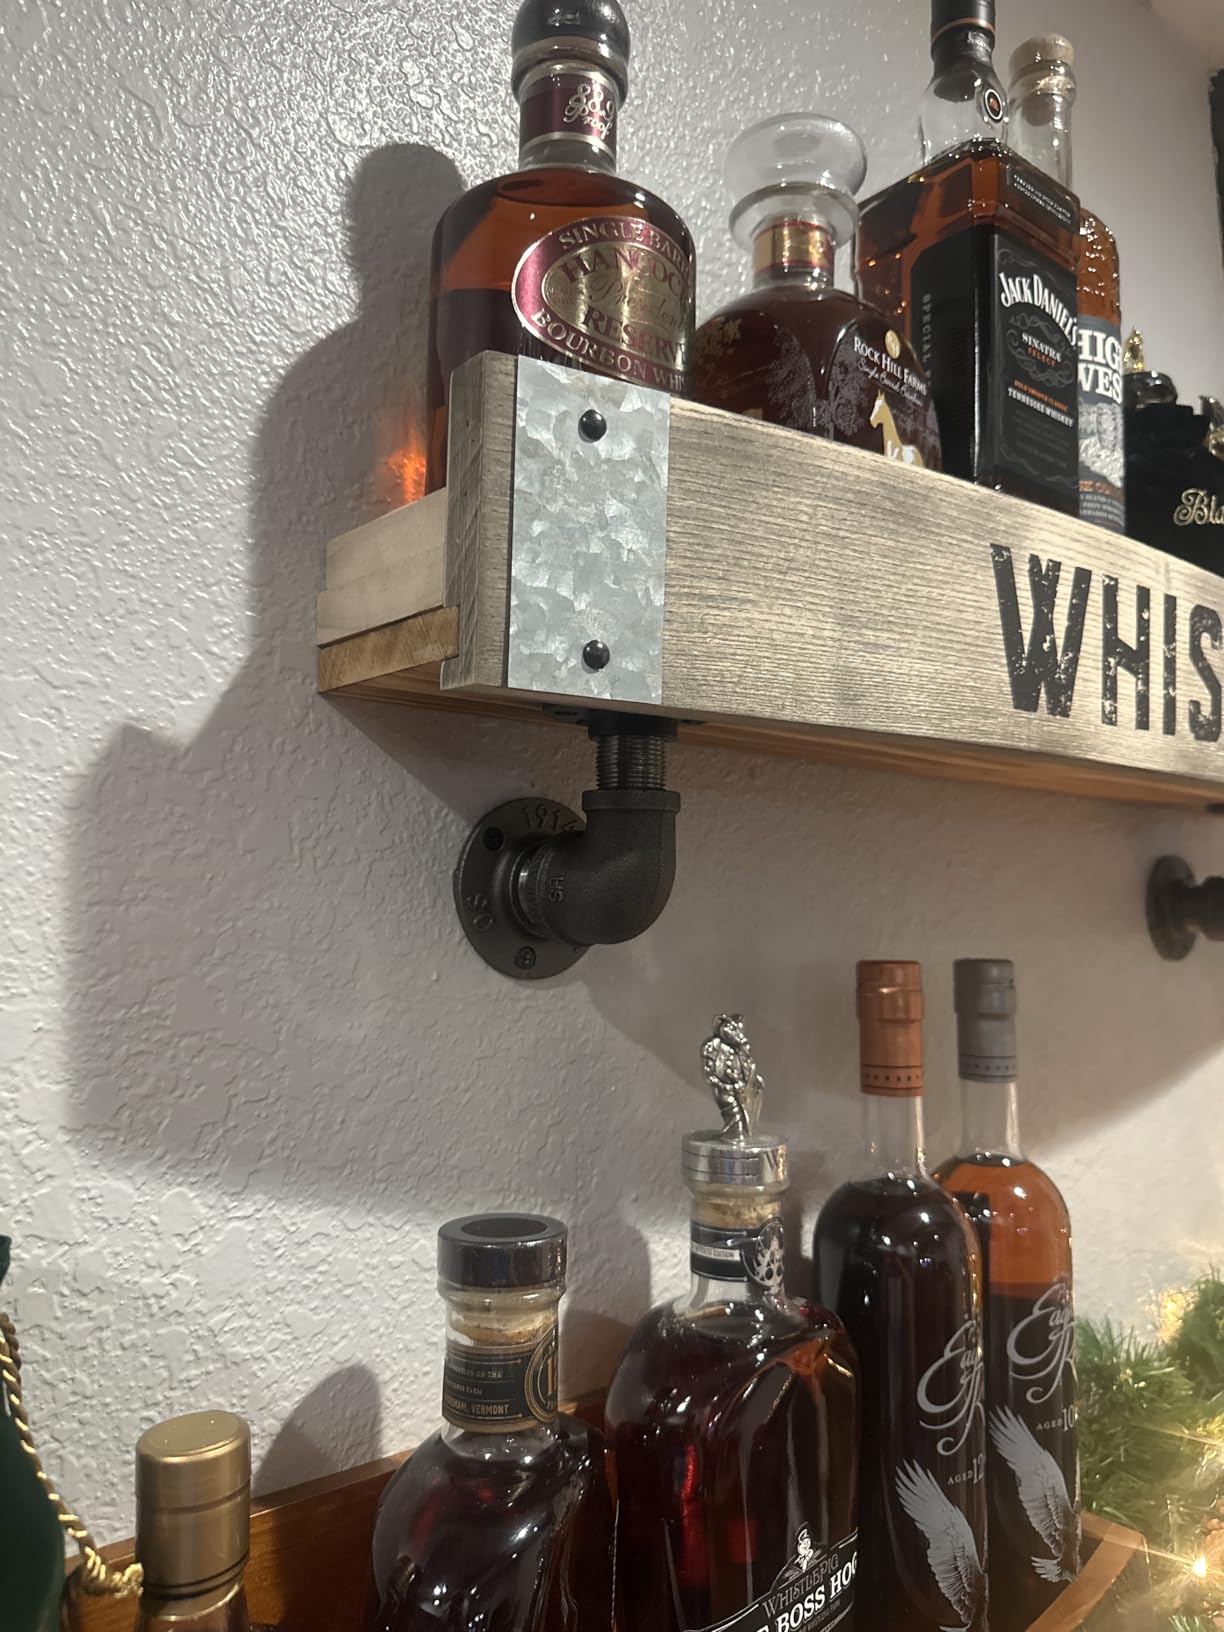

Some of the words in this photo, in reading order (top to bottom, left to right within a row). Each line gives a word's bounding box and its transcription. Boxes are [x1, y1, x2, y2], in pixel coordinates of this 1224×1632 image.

[558, 222, 645, 250] SINGLE
[921, 293, 932, 363] SPECIAL
[999, 271, 1033, 308] JACK
[1033, 273, 1078, 346] DANIEL'S
[530, 307, 648, 380] BOURBON
[1021, 332, 1062, 363] SINATRA
[1027, 346, 1057, 368] SELECT
[854, 335, 881, 367] ROCK
[881, 353, 903, 380] HILL
[903, 367, 928, 397] FARMS
[1007, 387, 1045, 414] TENNESSEE
[1045, 407, 1074, 428] WHISKEY
[989, 542, 1223, 743] WHIS
[471, 1403, 510, 1416] VERMONT
[1036, 1419, 1062, 1431] AGED
[947, 1470, 974, 1486] AGED
[762, 1553, 839, 1619] WHISTLEPIG
[776, 1584, 826, 1632] BOSS
